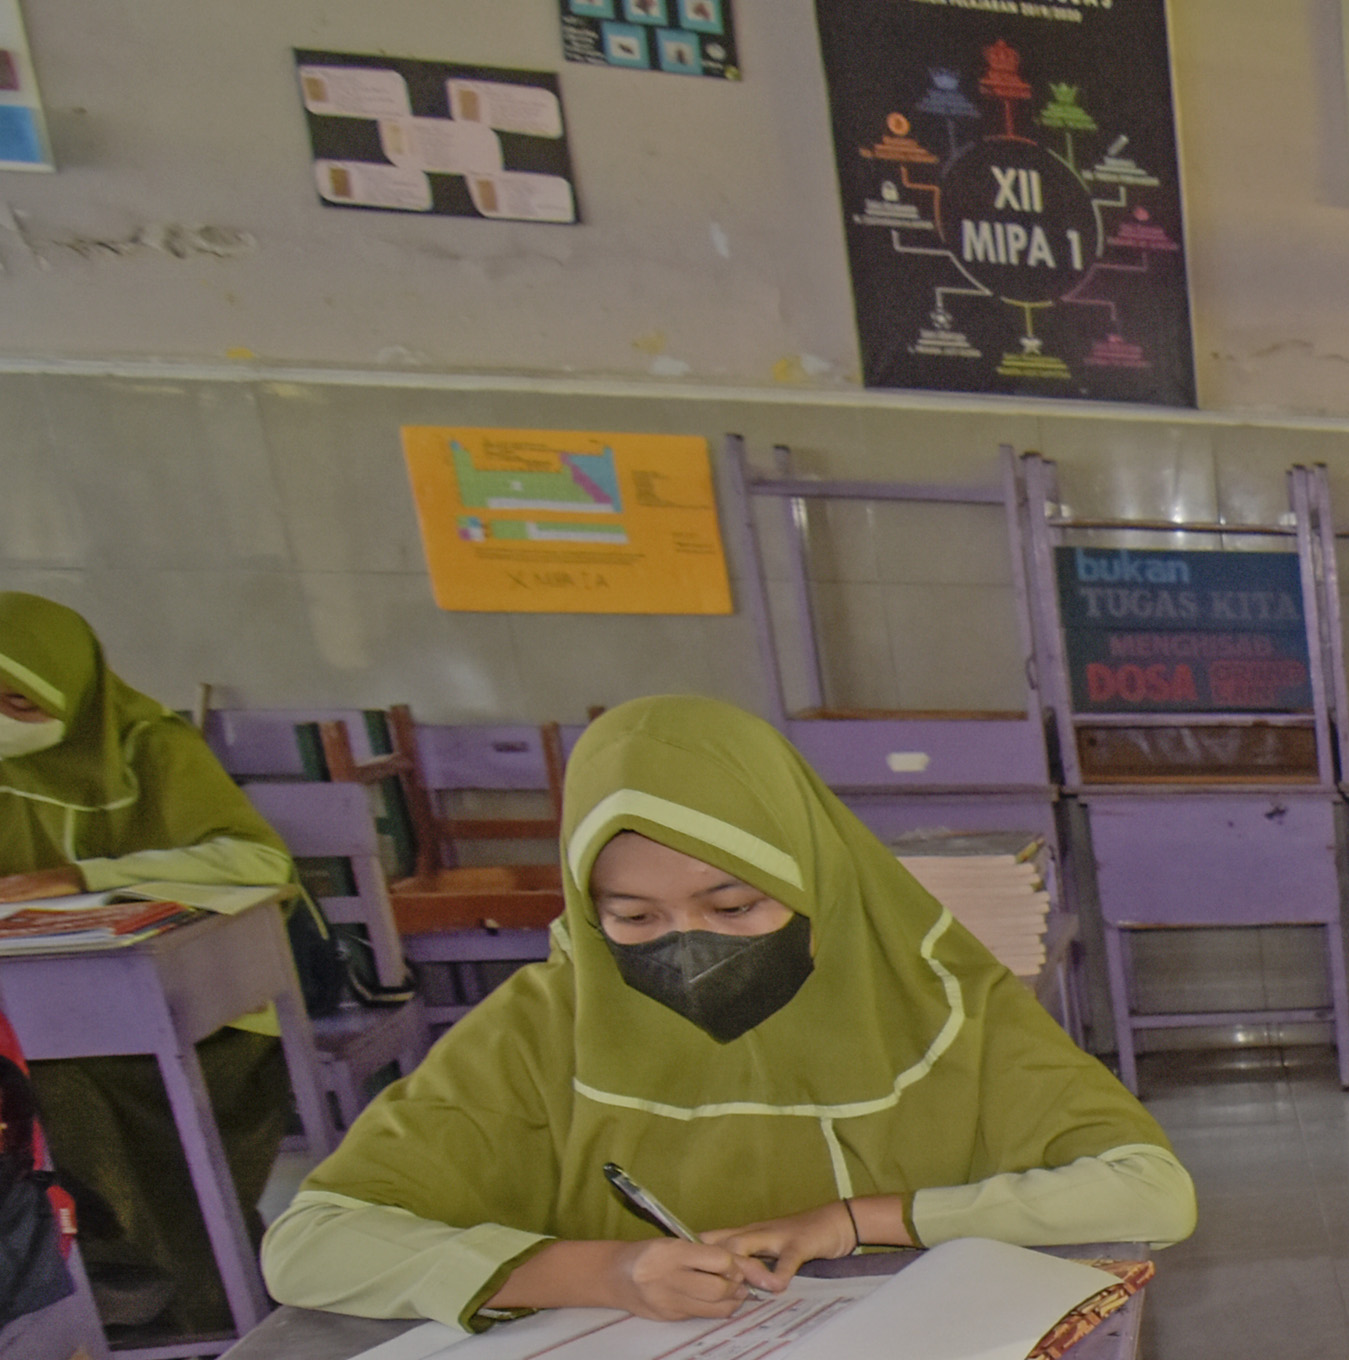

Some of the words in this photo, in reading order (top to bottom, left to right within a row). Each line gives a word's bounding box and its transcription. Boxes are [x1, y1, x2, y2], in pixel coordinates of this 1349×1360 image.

[990, 165, 1043, 213] XII
[961, 219, 1056, 270] MIPA
[1067, 230, 1084, 270] 1
[1076, 547, 1190, 583] bukan
[1080, 587, 1198, 620] TUGAS
[1210, 592, 1299, 621] KITA
[1086, 662, 1198, 702] DOSA
